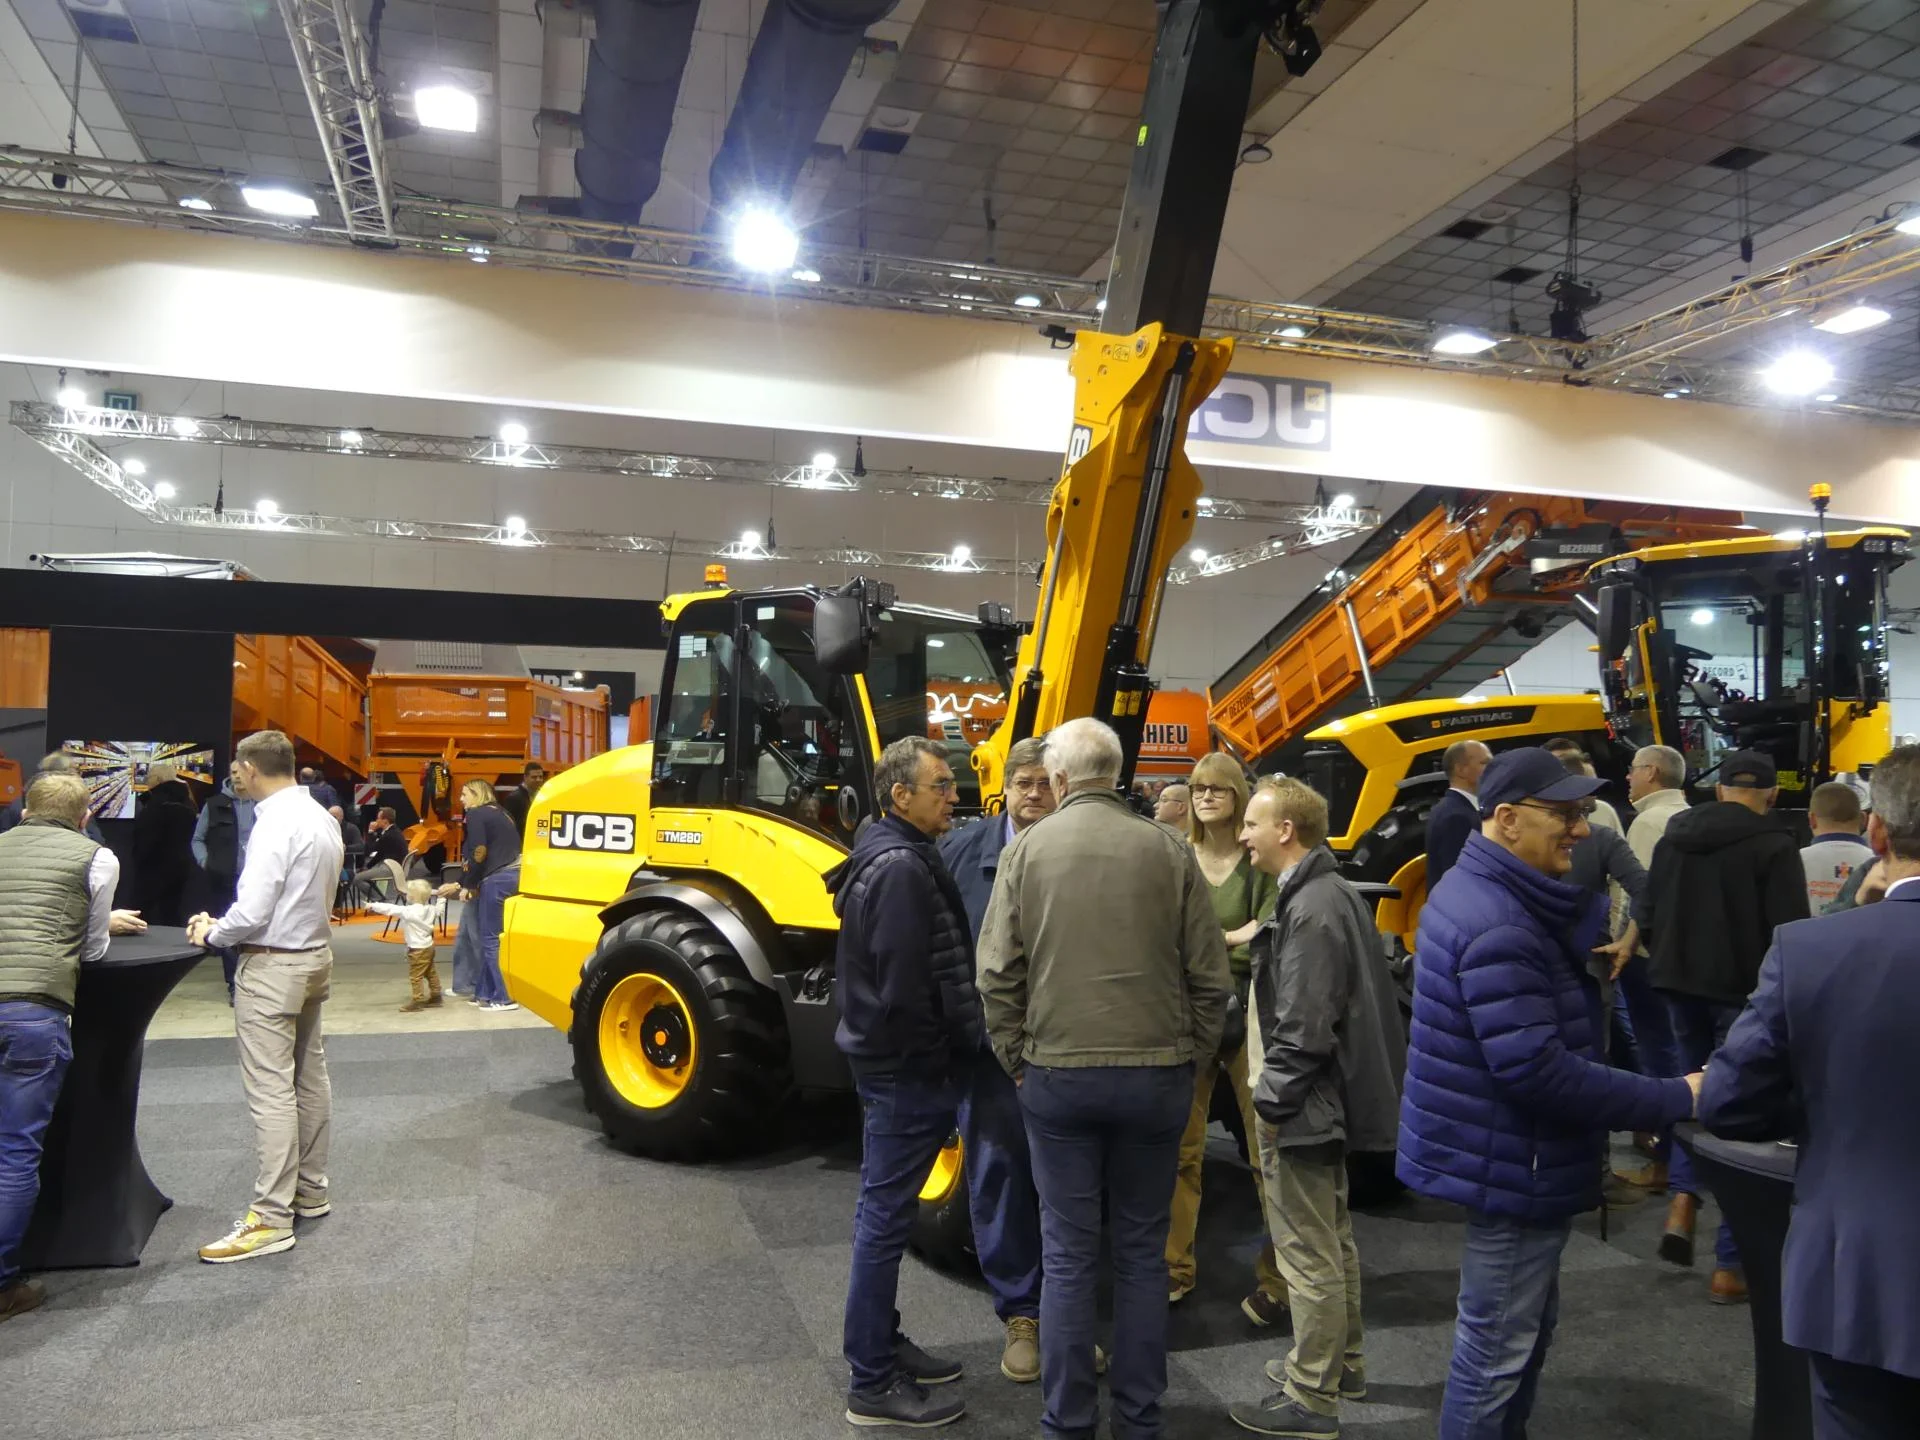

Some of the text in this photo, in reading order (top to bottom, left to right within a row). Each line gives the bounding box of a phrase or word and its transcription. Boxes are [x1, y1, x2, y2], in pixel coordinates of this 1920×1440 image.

[1558, 544, 1604, 554] DEZEURE
[1228, 687, 1256, 719] DEZEURE
[1441, 711, 1513, 728] FASTRAC
[1143, 723, 1189, 745] HIEU
[550, 813, 634, 851] JCB
[664, 831, 701, 844] TM280
